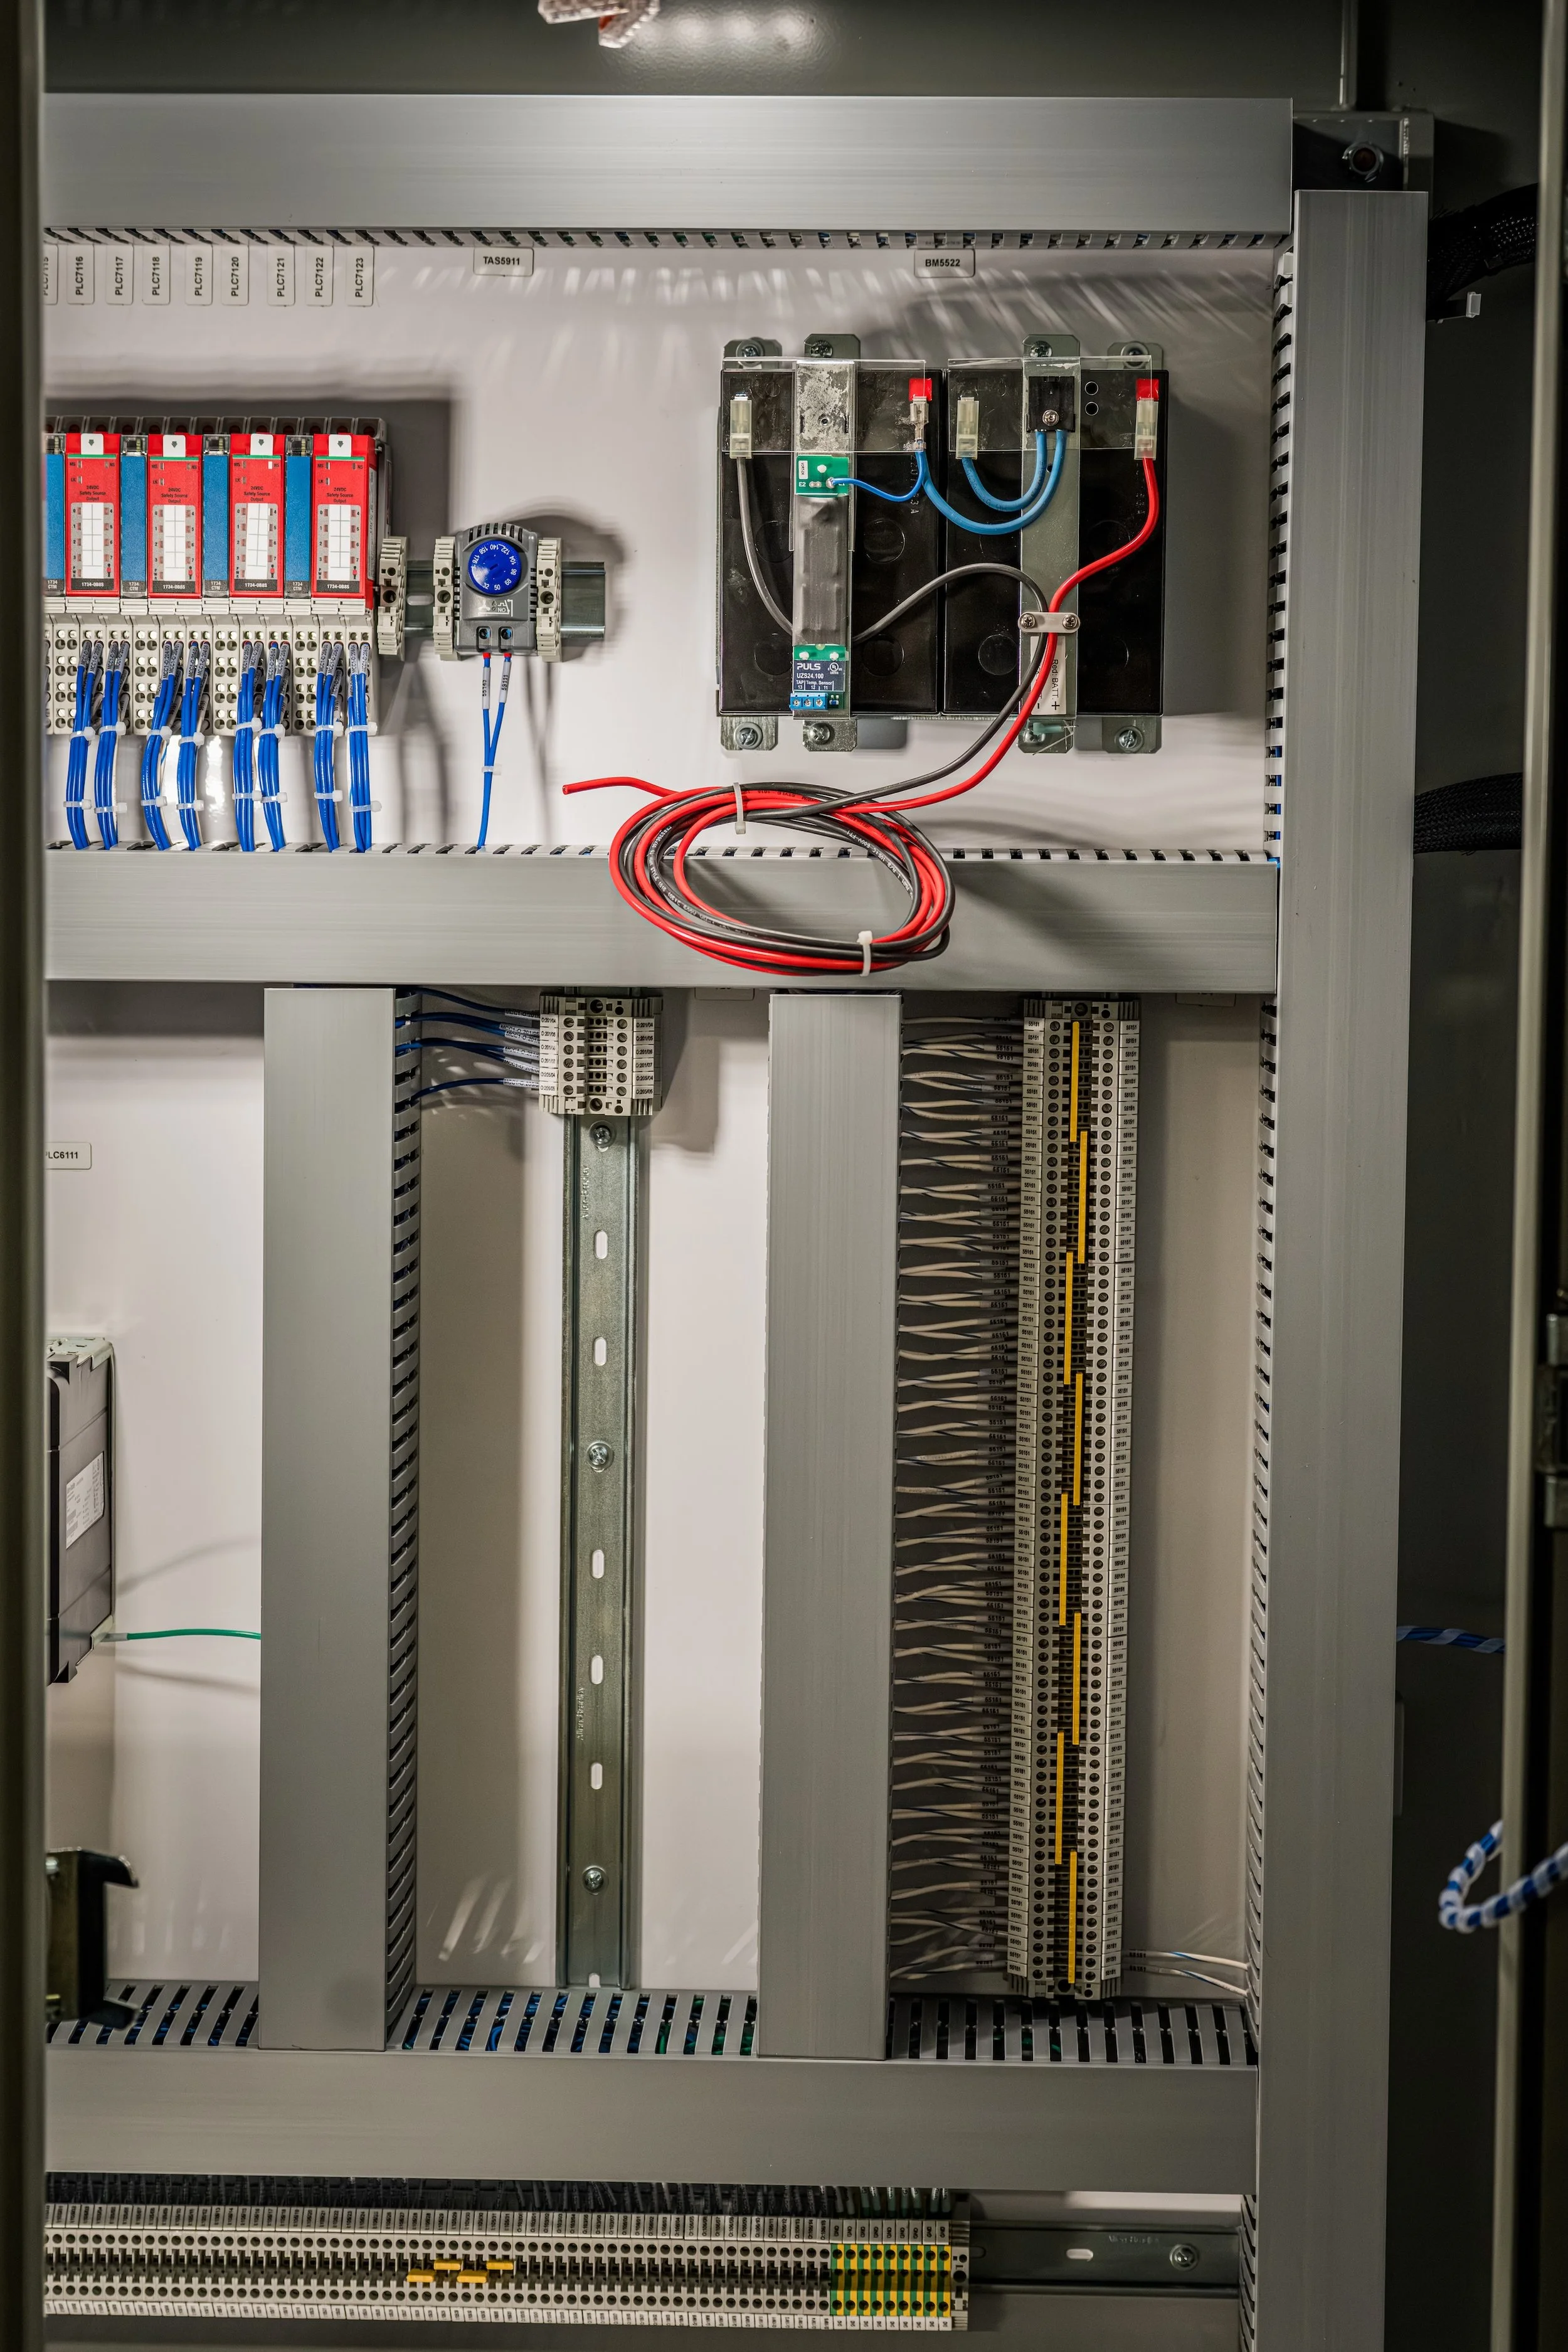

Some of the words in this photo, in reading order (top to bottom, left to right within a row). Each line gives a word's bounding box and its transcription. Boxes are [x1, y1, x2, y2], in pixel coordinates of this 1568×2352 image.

[483, 256, 519, 265] TAS5911
[75, 256, 83, 295] PLC7116
[115, 256, 124, 295] PLC7117
[315, 257, 324, 297] PLC7122
[356, 257, 364, 298] PLC7123
[479, 546, 488, 554] 158
[501, 546, 510, 555] 122
[858, 839, 870, 848] 600V
